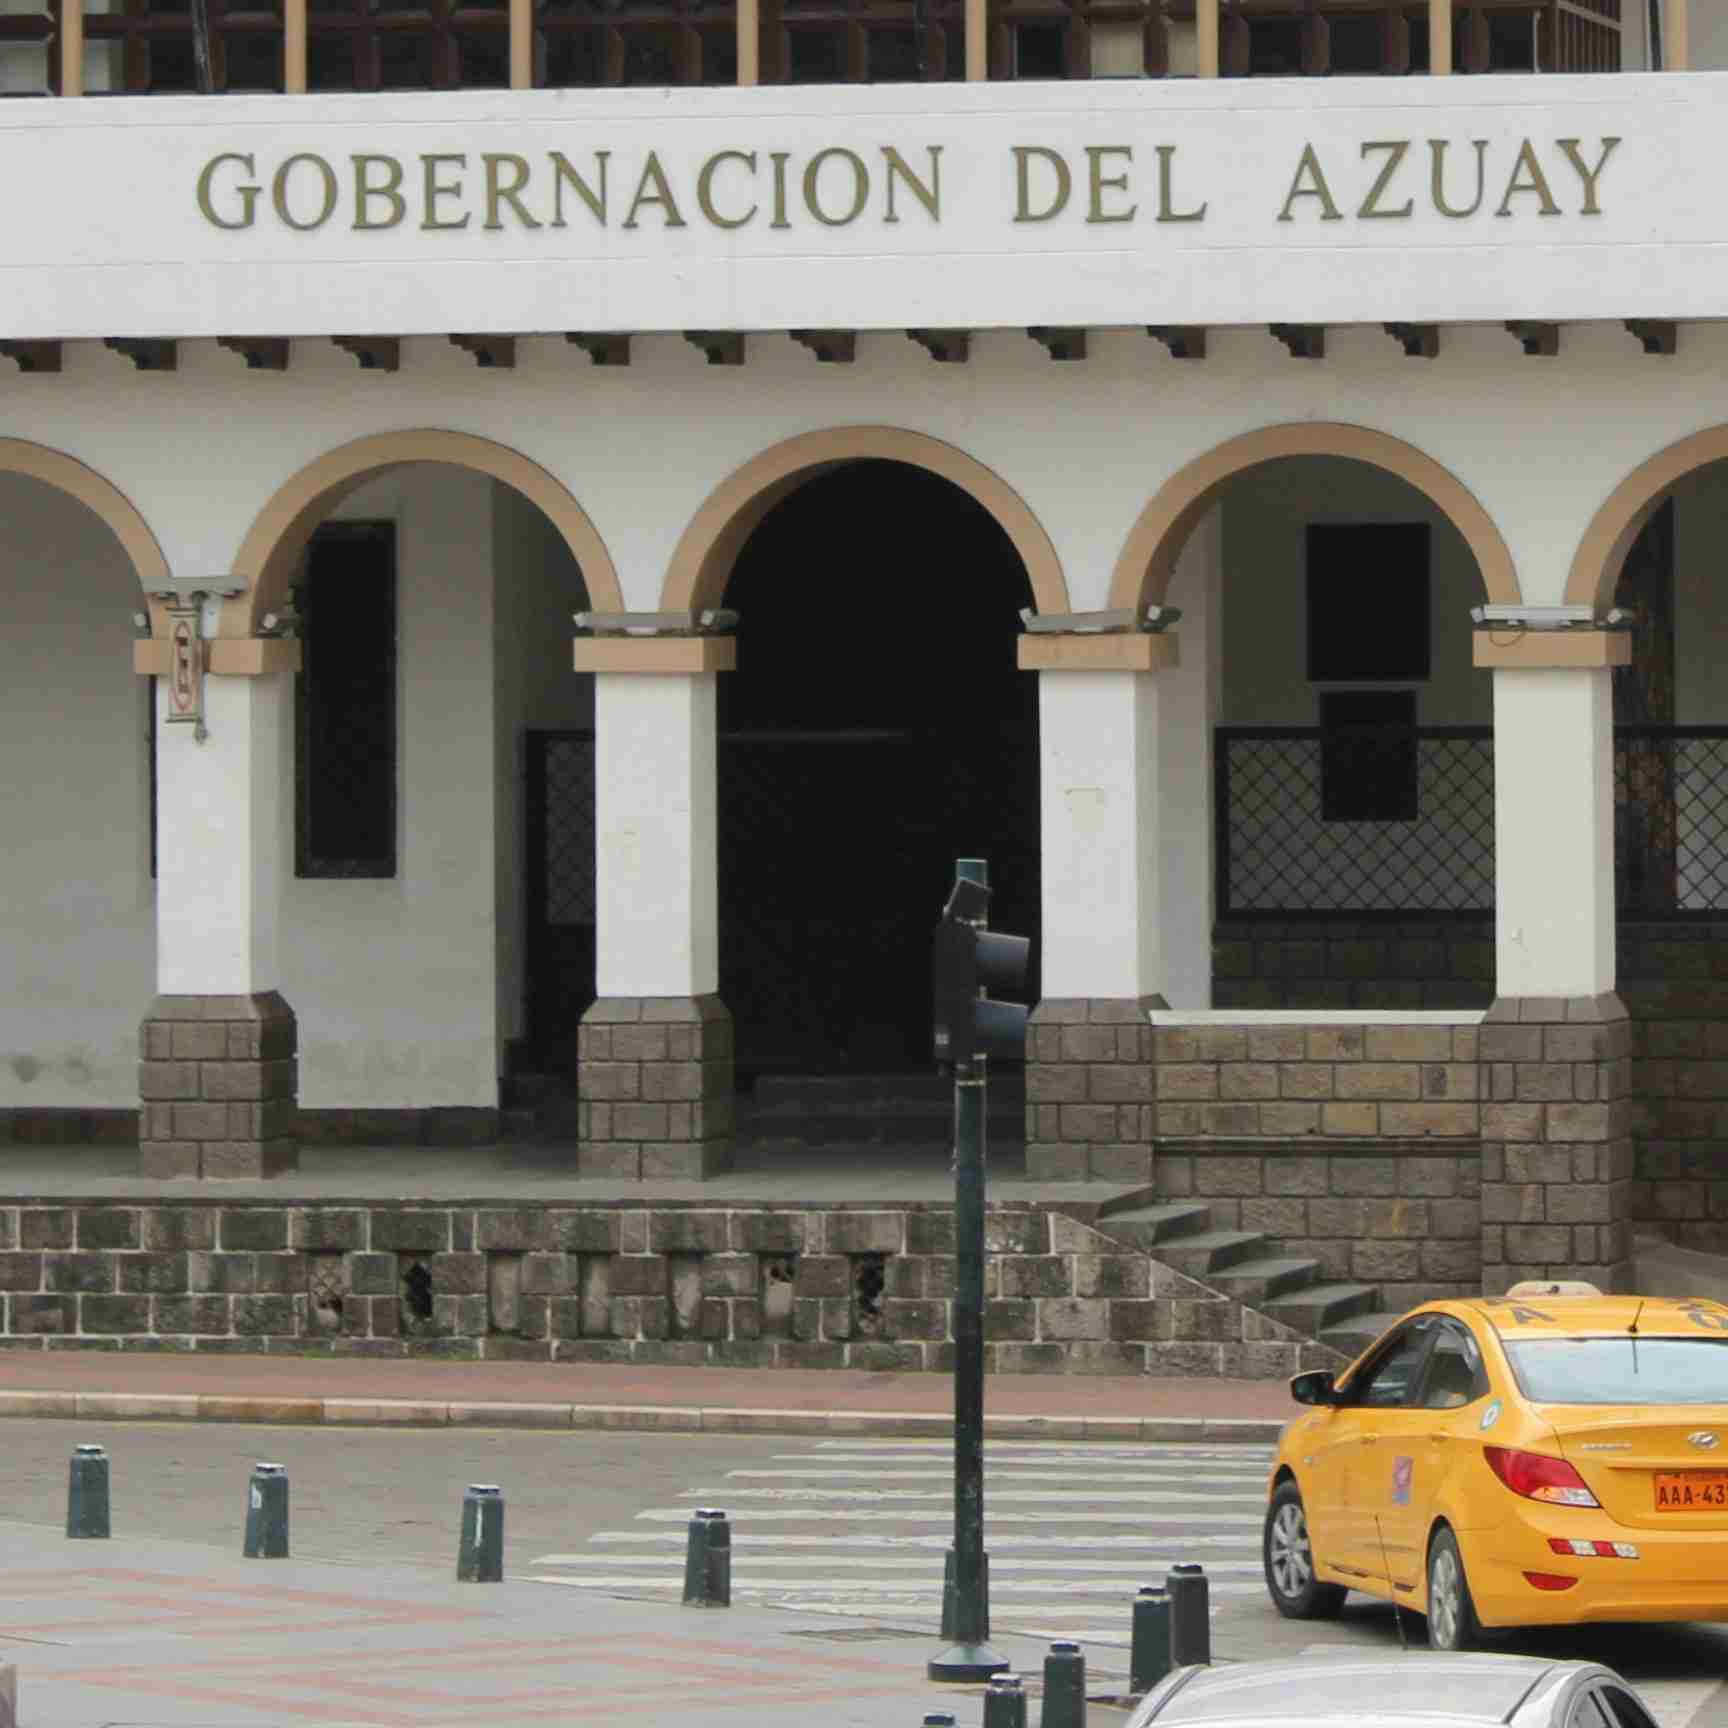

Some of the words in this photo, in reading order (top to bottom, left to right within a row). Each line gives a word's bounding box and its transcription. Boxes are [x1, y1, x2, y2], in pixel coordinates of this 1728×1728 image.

[195, 145, 943, 232] GOBERNACION
[1010, 144, 1207, 224] DEL
[1276, 136, 1622, 222] AZUAY
